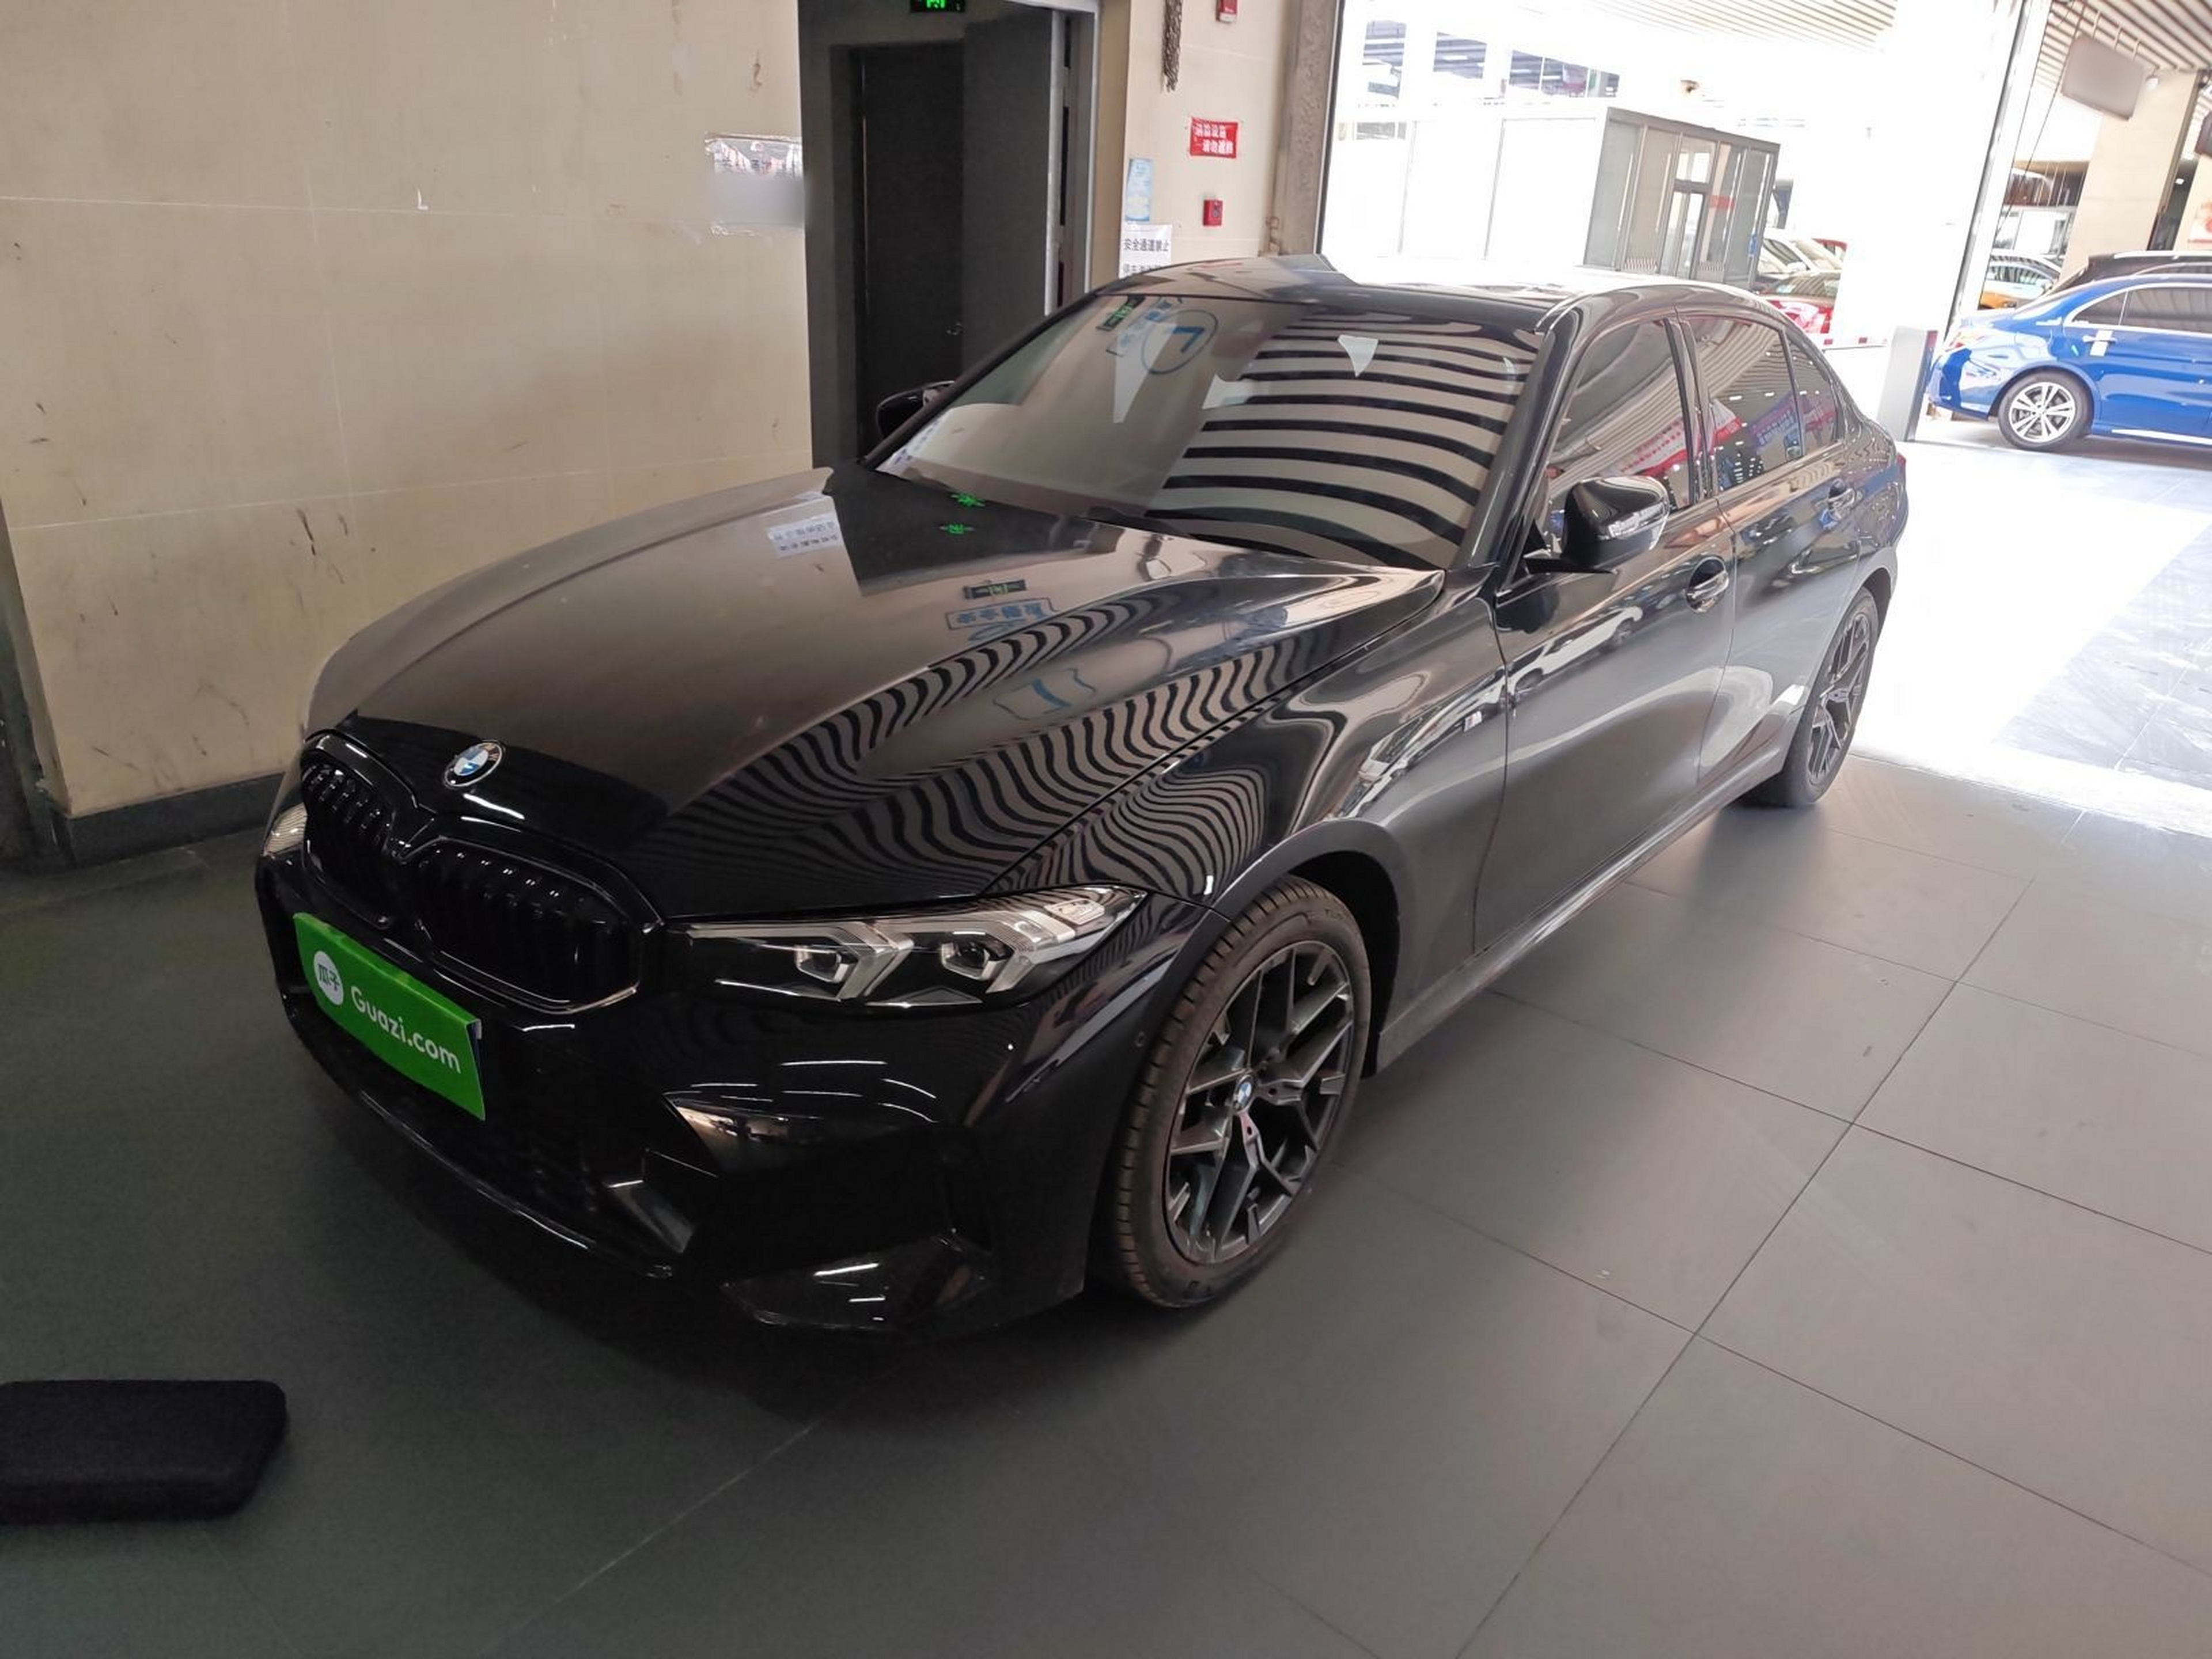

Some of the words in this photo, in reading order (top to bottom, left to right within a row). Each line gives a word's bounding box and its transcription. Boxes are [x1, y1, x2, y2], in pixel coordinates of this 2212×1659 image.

[1124, 238, 1169, 252] 安全通道禁止
[317, 963, 340, 992] 瓜子
[351, 986, 461, 1074] Guazi.com
